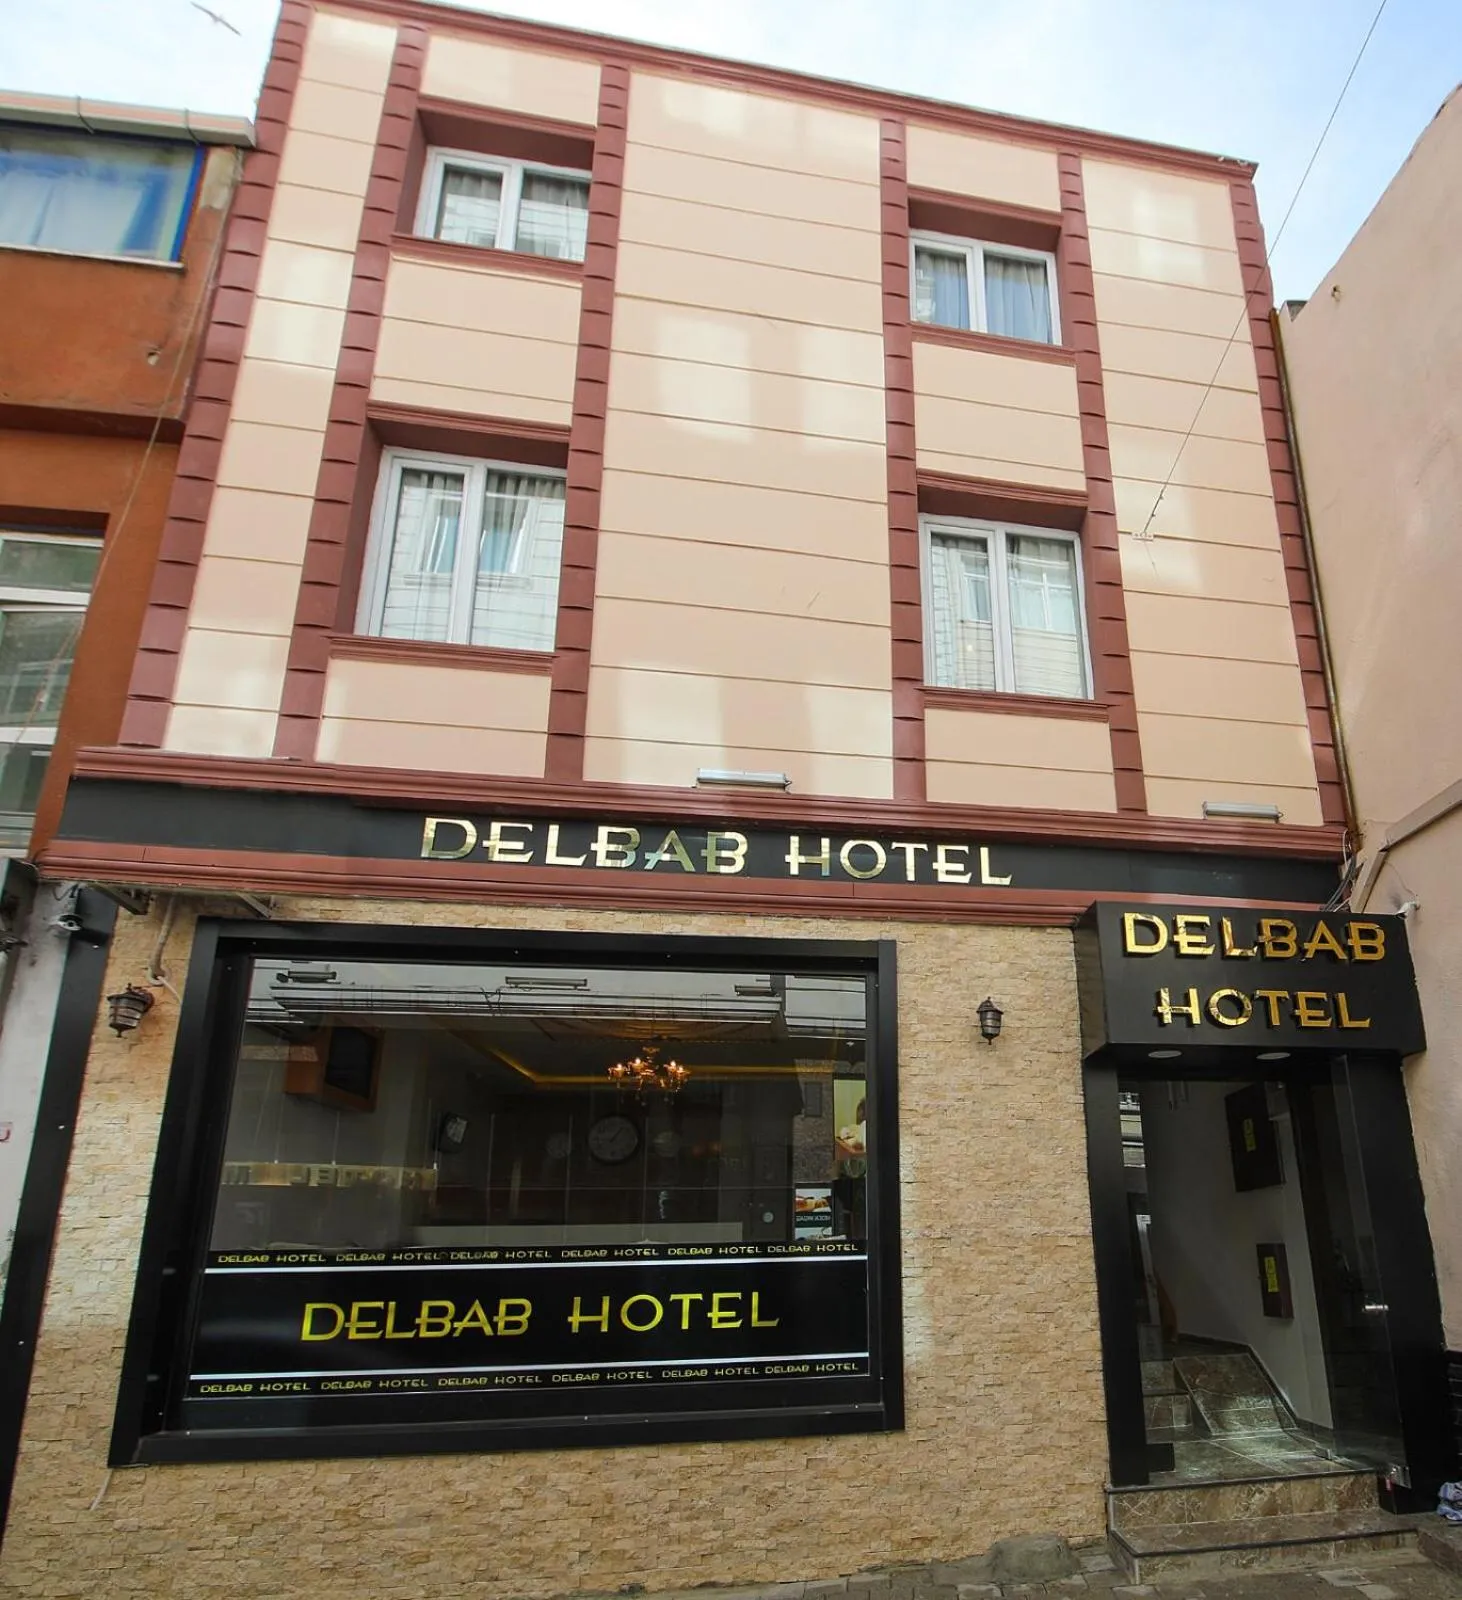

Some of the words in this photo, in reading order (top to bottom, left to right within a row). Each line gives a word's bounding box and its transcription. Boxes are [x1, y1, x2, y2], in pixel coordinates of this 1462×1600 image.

[420, 816, 748, 874] DELBAB
[785, 835, 1012, 886] HOTEL
[1122, 911, 1386, 962] DELBAB
[1156, 986, 1371, 1028] HOTEL
[217, 1254, 270, 1263] DELBAB
[276, 1254, 327, 1263] HOTEL
[336, 1253, 386, 1262] DELBAB
[392, 1252, 441, 1261] HOTEL
[450, 1251, 498, 1260] DELBAB
[505, 1250, 552, 1259] HOTEL
[561, 1249, 608, 1258] DELBAB
[613, 1248, 660, 1257] HOTEL
[667, 1247, 713, 1256] DELBAB
[718, 1246, 762, 1254] HOTEL
[767, 1245, 811, 1253] DELBAB
[816, 1243, 858, 1252] HOTEL
[301, 1298, 533, 1341] DELBAB
[567, 1292, 780, 1333] HOTEL
[200, 1384, 253, 1393] DELBAB
[259, 1382, 311, 1391] HOTEL
[320, 1381, 372, 1390] DELBAB
[379, 1378, 428, 1387] HOTEL
[438, 1376, 488, 1386] DELBAB
[494, 1375, 542, 1384] HOTEL
[551, 1373, 600, 1382] DELBAB
[606, 1371, 653, 1380] HOTEL
[662, 1369, 708, 1378] DELBAB
[714, 1367, 760, 1376] HOTEL
[764, 1365, 810, 1374] DELBAB
[815, 1362, 859, 1372] HOTEL
